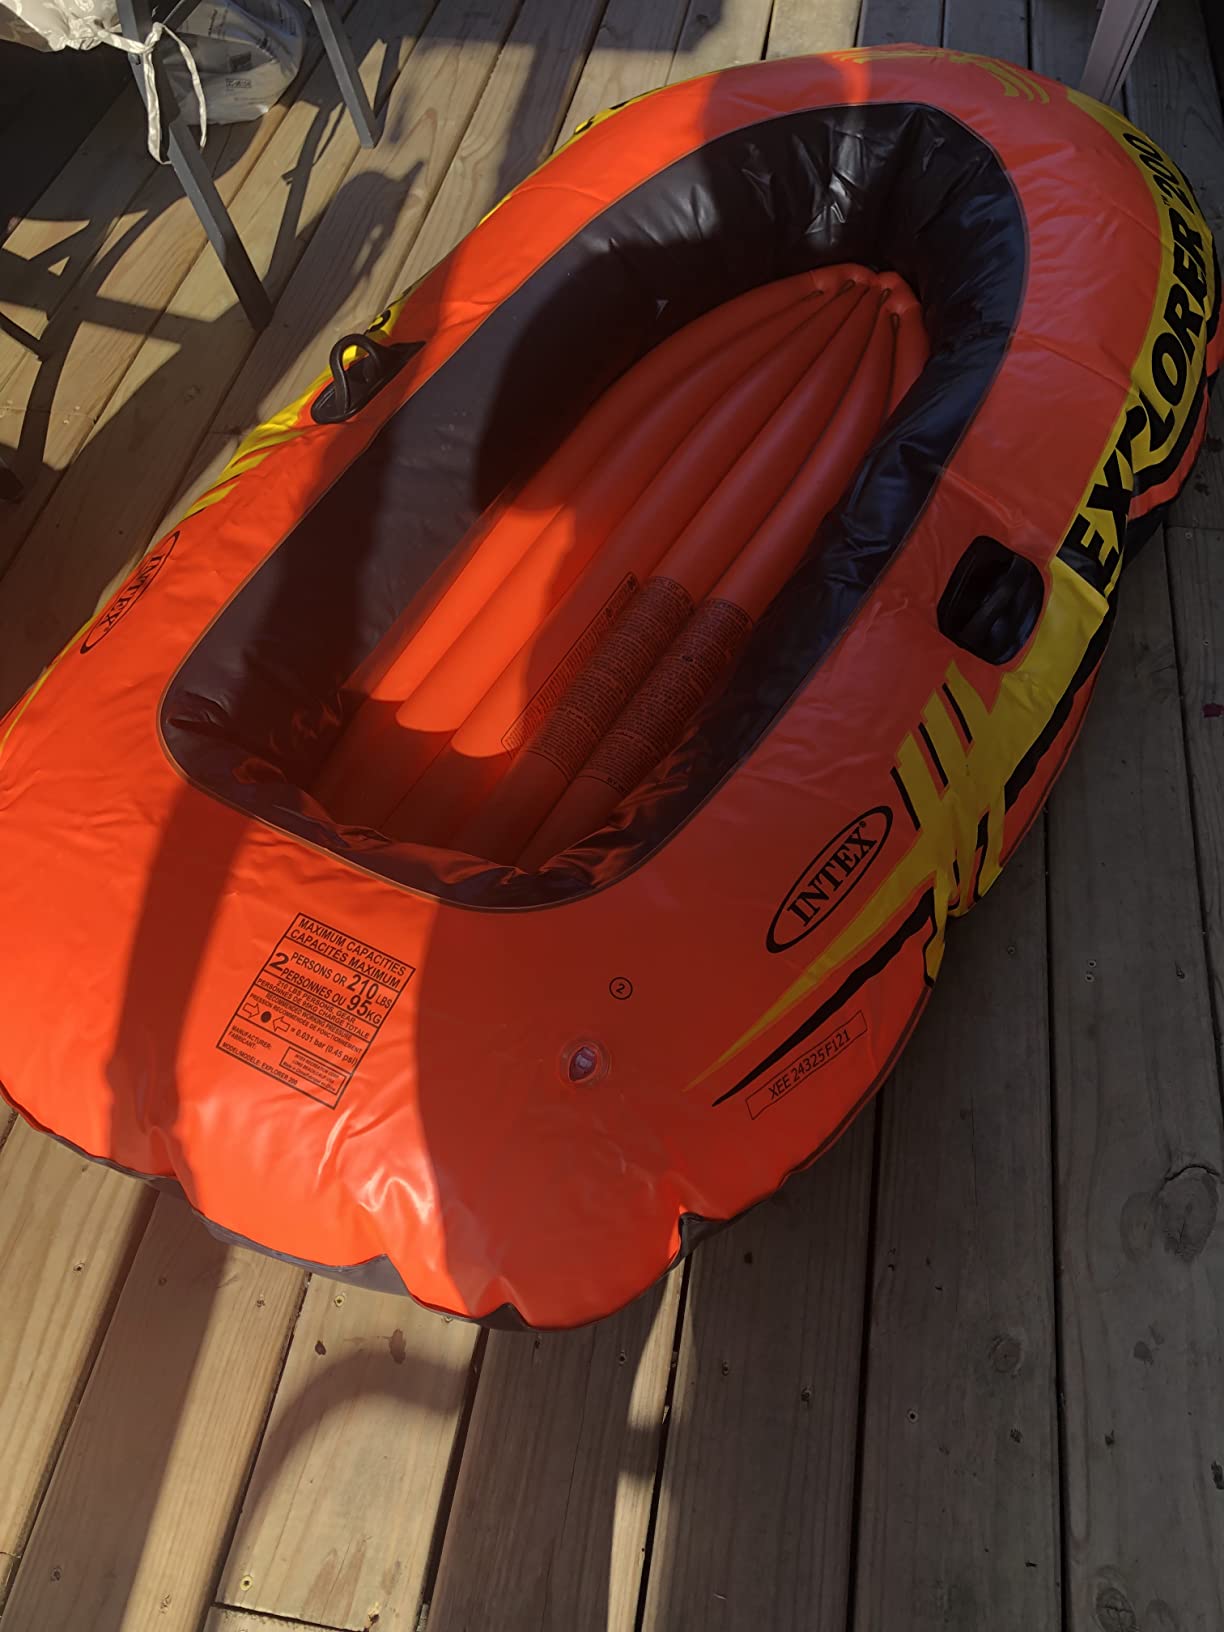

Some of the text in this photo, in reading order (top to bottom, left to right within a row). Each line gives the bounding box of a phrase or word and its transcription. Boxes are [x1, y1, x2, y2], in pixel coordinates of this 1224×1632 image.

[1123, 133, 1195, 214] 200
[289, 928, 401, 988] CAPACITÉS MAXIMUM
[298, 918, 407, 976] MAXIMUM CAPACITIES
[256, 978, 292, 999] PERSONNES
[318, 1009, 344, 1025] CHARGE
[345, 1023, 369, 1038] TOTALE
[269, 951, 392, 1008] 2 PERSONS OR 210 LBS
[277, 981, 288, 989] 210
[288, 986, 301, 995] LBS
[336, 1010, 355, 1023] GEAR
[280, 967, 332, 999] PERSONNES
[331, 992, 346, 1006] OU
[614, 981, 627, 995] 2
[295, 1030, 314, 1043] 0.031
[313, 1039, 325, 1049] bar
[324, 1045, 343, 1059] (0.45
[341, 1054, 358, 1067] psi)
[767, 1029, 852, 1100] XEE 24325F121
